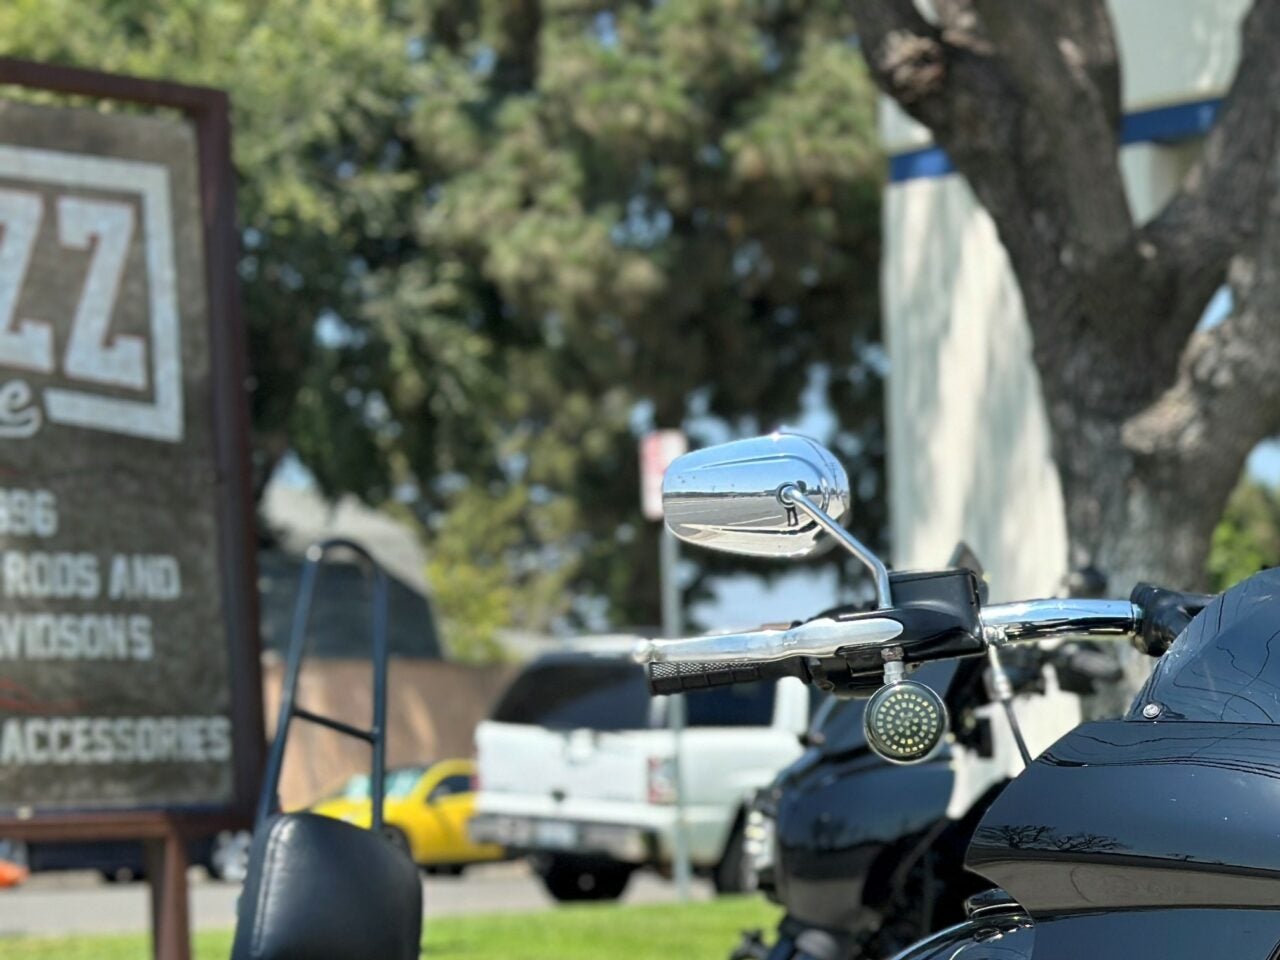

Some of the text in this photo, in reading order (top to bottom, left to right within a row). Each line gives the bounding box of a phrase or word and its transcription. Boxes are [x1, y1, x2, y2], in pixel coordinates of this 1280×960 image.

[3, 552, 182, 600] RODS AND
[2, 715, 232, 765] ACCESSORIES
